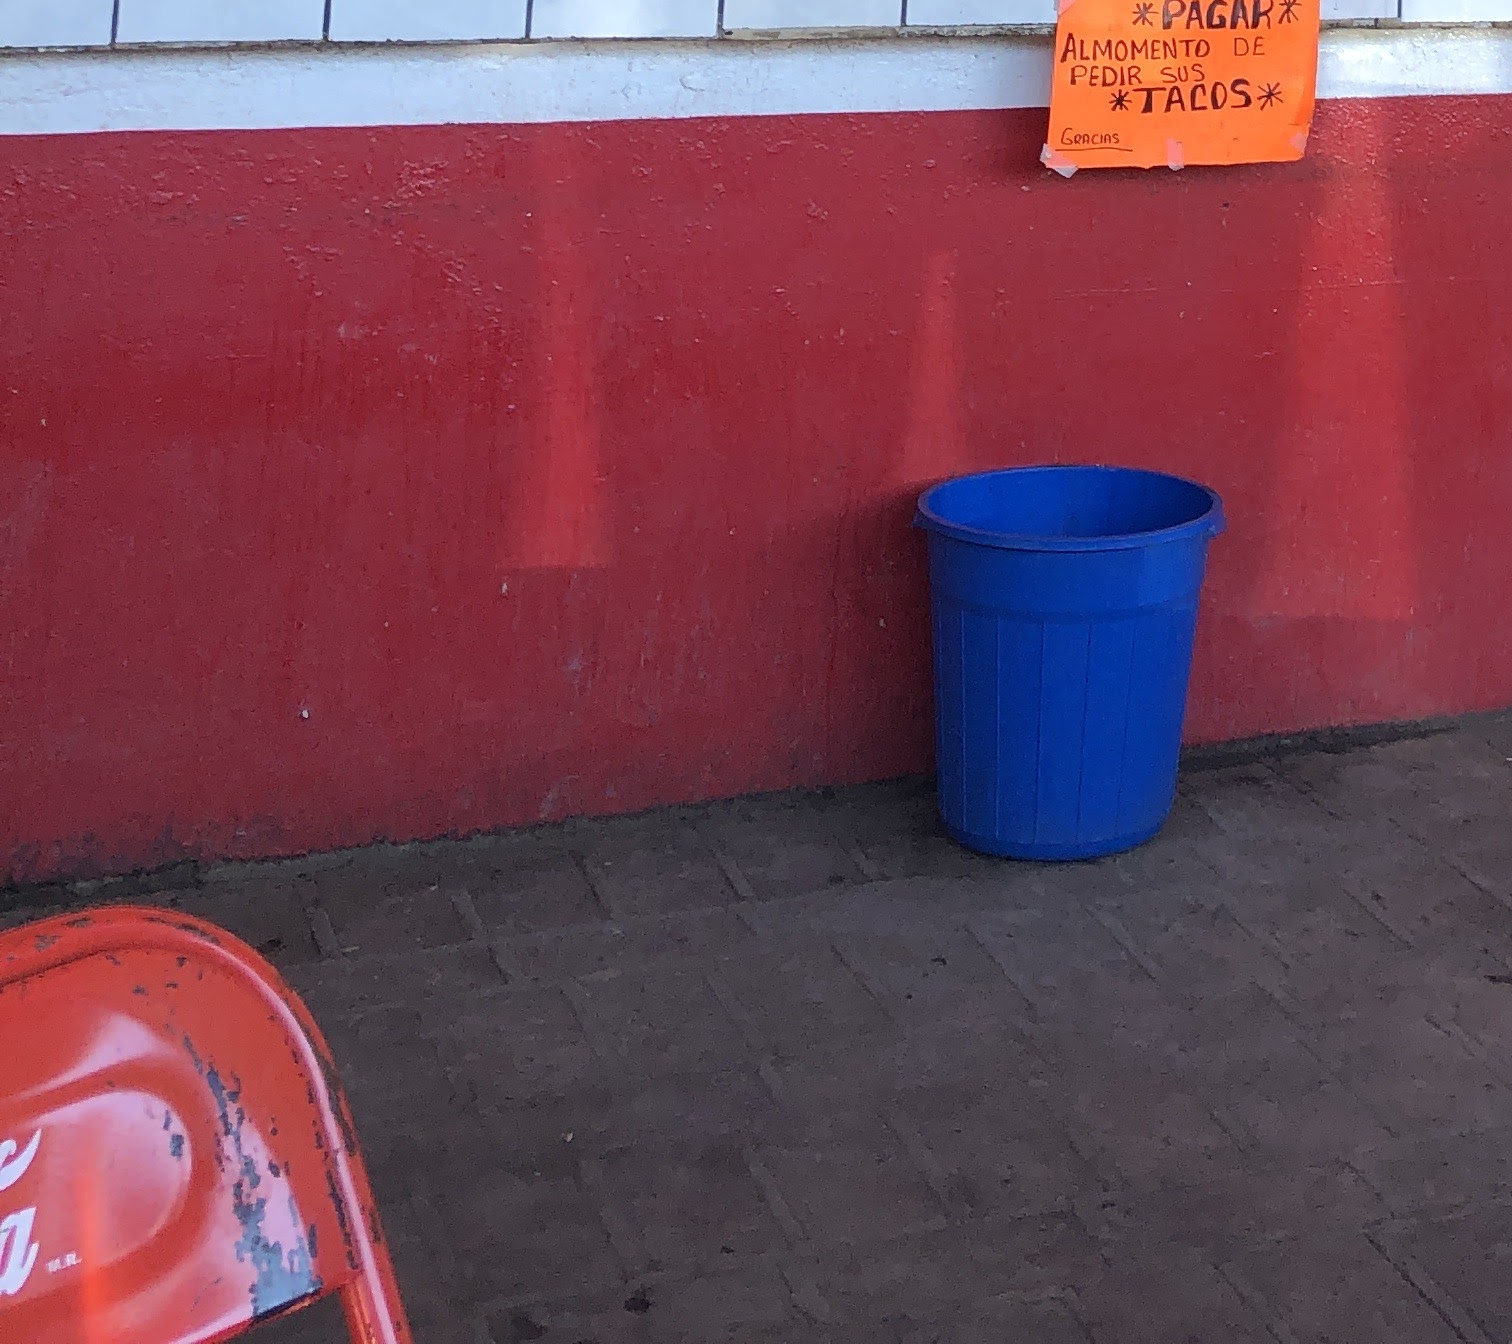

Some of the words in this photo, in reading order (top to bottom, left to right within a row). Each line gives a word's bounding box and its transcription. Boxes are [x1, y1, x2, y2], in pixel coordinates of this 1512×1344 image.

[1234, 36, 1265, 56] DE
[1070, 65, 1142, 87] PEDIR
[1160, 64, 1206, 83] SUS
